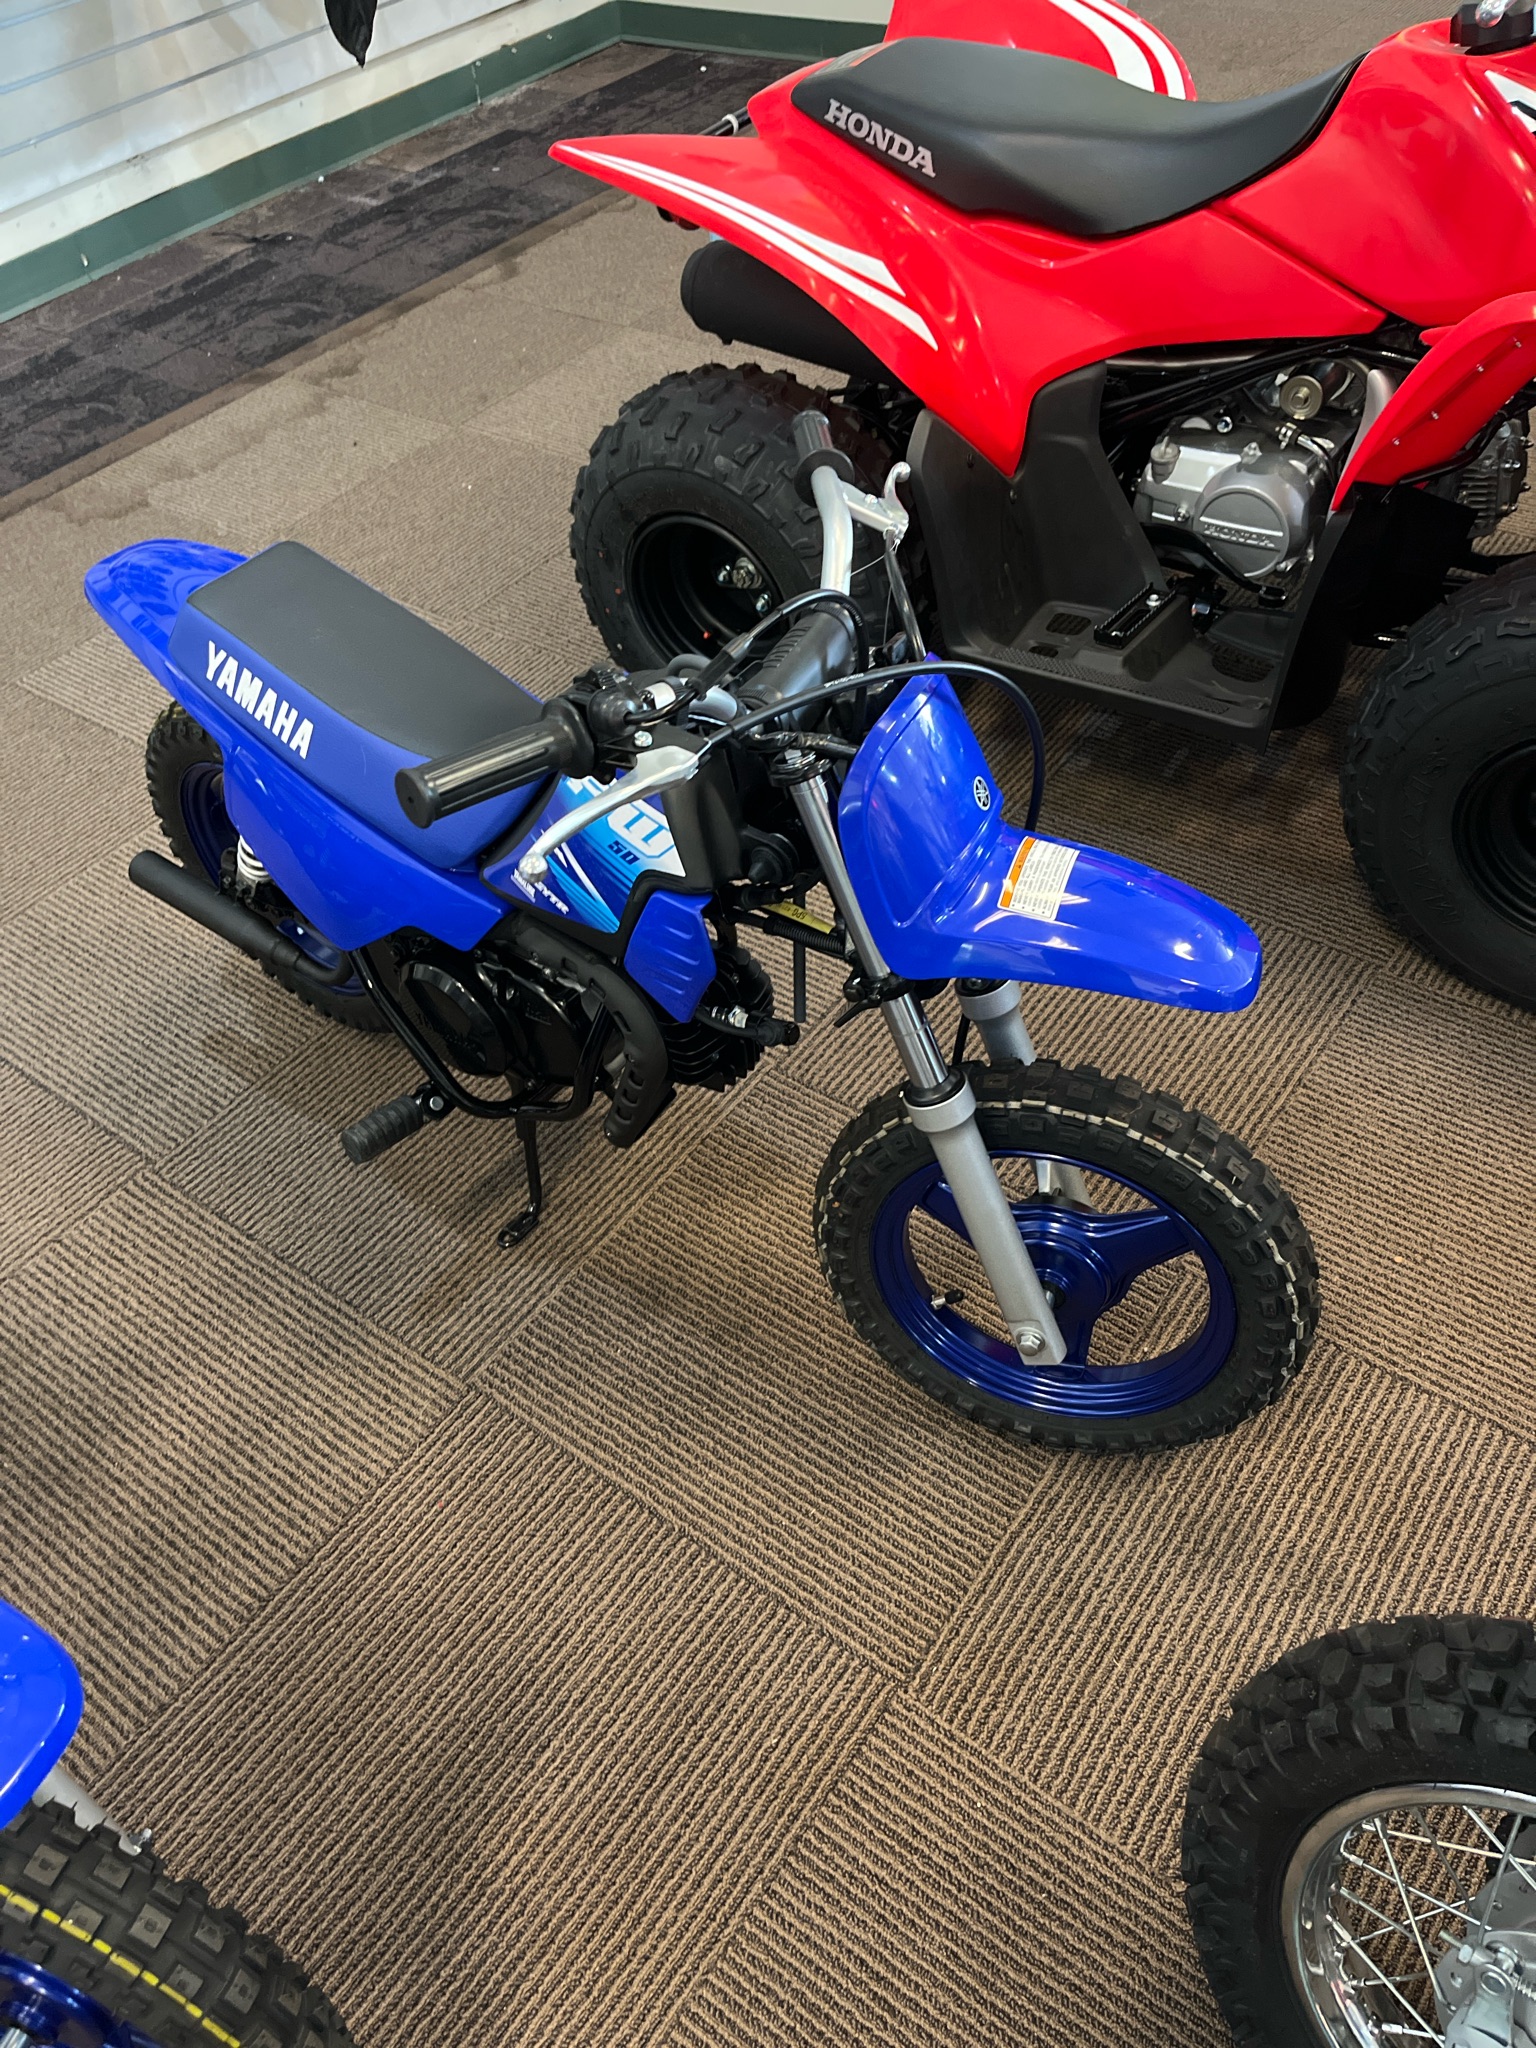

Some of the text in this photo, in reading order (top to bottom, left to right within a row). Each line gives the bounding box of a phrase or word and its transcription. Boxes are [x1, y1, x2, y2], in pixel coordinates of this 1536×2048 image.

[824, 98, 936, 178] HONDA
[1203, 523, 1275, 547] HONDA
[206, 640, 314, 760] YAMAHA
[607, 839, 640, 866] 50
